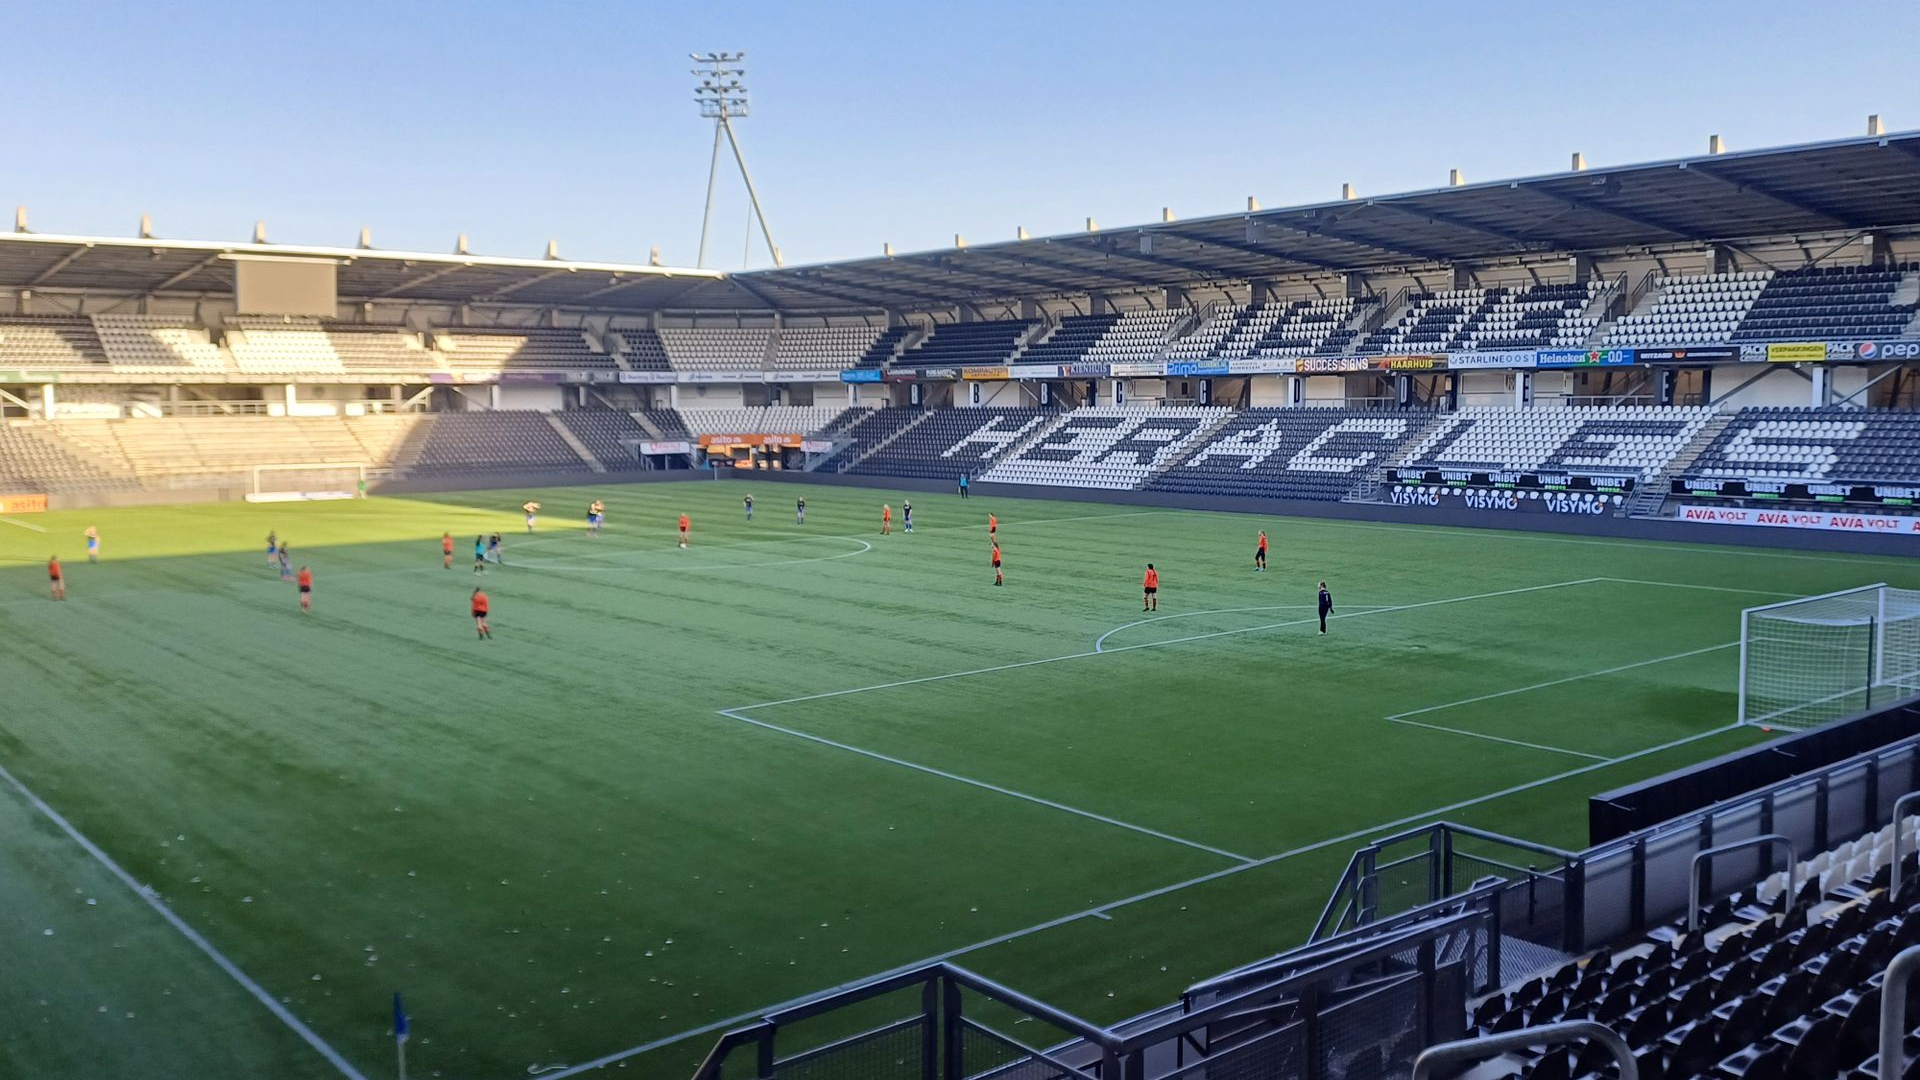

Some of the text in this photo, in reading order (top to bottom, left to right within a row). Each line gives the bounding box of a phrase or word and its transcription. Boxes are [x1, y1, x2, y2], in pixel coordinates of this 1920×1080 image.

[1539, 352, 1586, 363] Heineken
[1071, 363, 1107, 373] KIENHUIS
[1304, 358, 1368, 371] SUCCES SIGNS
[1391, 359, 1433, 369] HAARHUIS
[973, 384, 979, 403] B
[1116, 382, 1123, 403] C
[1200, 380, 1206, 404] C
[711, 435, 732, 444] asito
[763, 435, 783, 444] asito
[1397, 469, 1426, 479] UNIBET
[1441, 472, 1472, 481] UNIBET
[1488, 473, 1521, 483] UNIBET
[1538, 475, 1573, 485] UNIBET
[1590, 477, 1627, 486] UNIBET
[1684, 480, 1725, 490] UNIBET
[1744, 482, 1787, 493] UNIBET
[1807, 485, 1853, 496] UNIBET
[1874, 486, 1920, 498] UNIBET
[1390, 492, 1440, 505] VISYMO
[1465, 495, 1518, 509] VISYMO
[1546, 500, 1604, 514] VISYMO
[1686, 508, 1748, 522] AVIA VOLT
[1757, 512, 1823, 526] AVIA VOLT
[1830, 516, 1900, 529] AVIA VOLT
